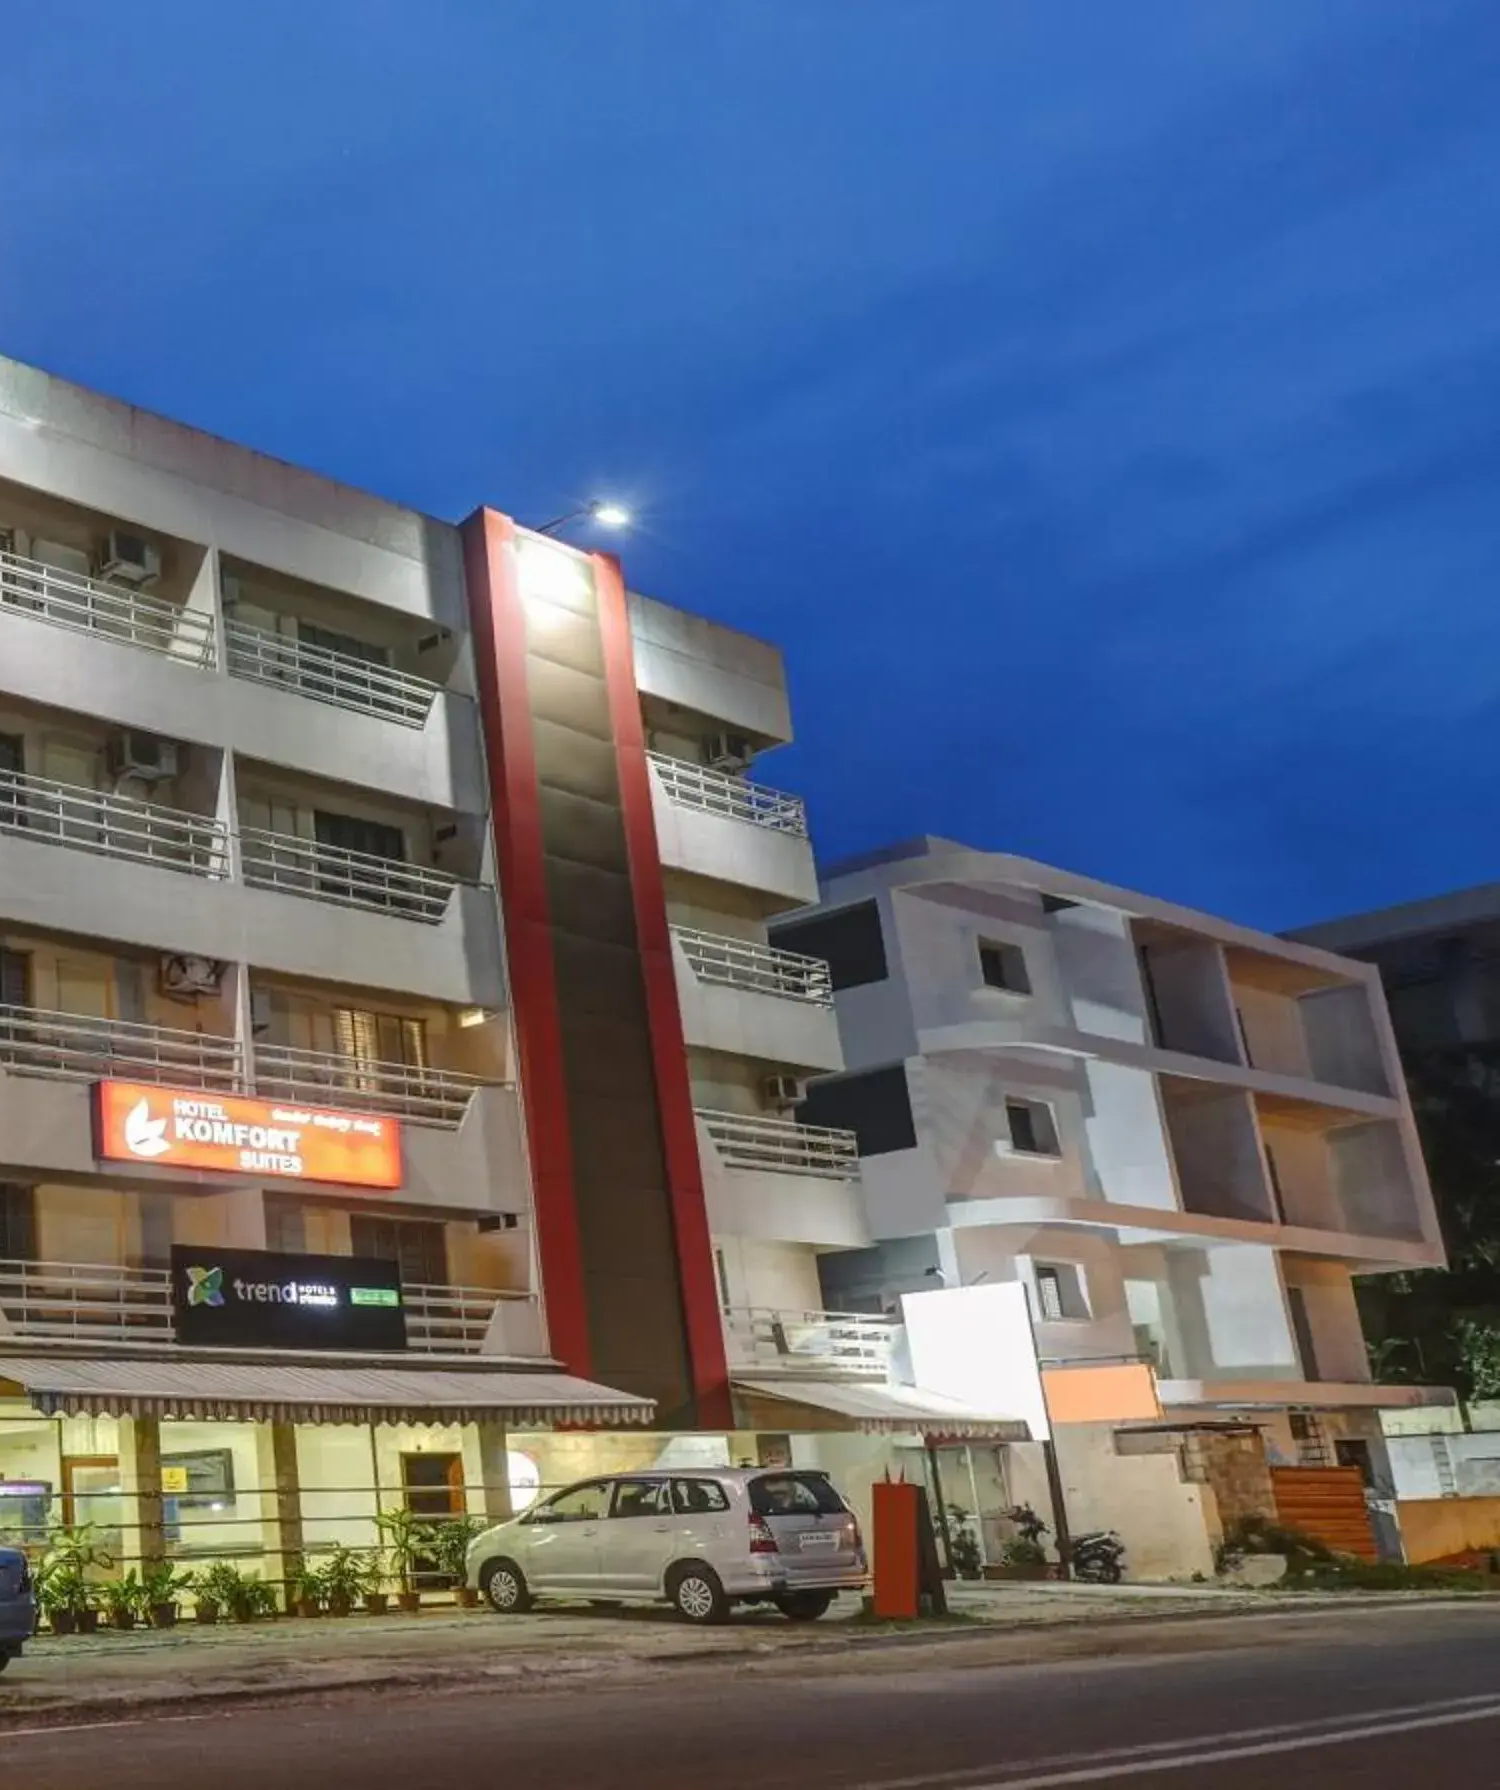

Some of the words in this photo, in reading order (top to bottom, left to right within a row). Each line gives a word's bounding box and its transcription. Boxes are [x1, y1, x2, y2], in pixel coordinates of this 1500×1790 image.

[173, 1100, 228, 1120] HOTEL
[175, 1119, 300, 1152] KOMFORT
[240, 1151, 302, 1172] SUITES
[233, 1279, 298, 1304] trend
